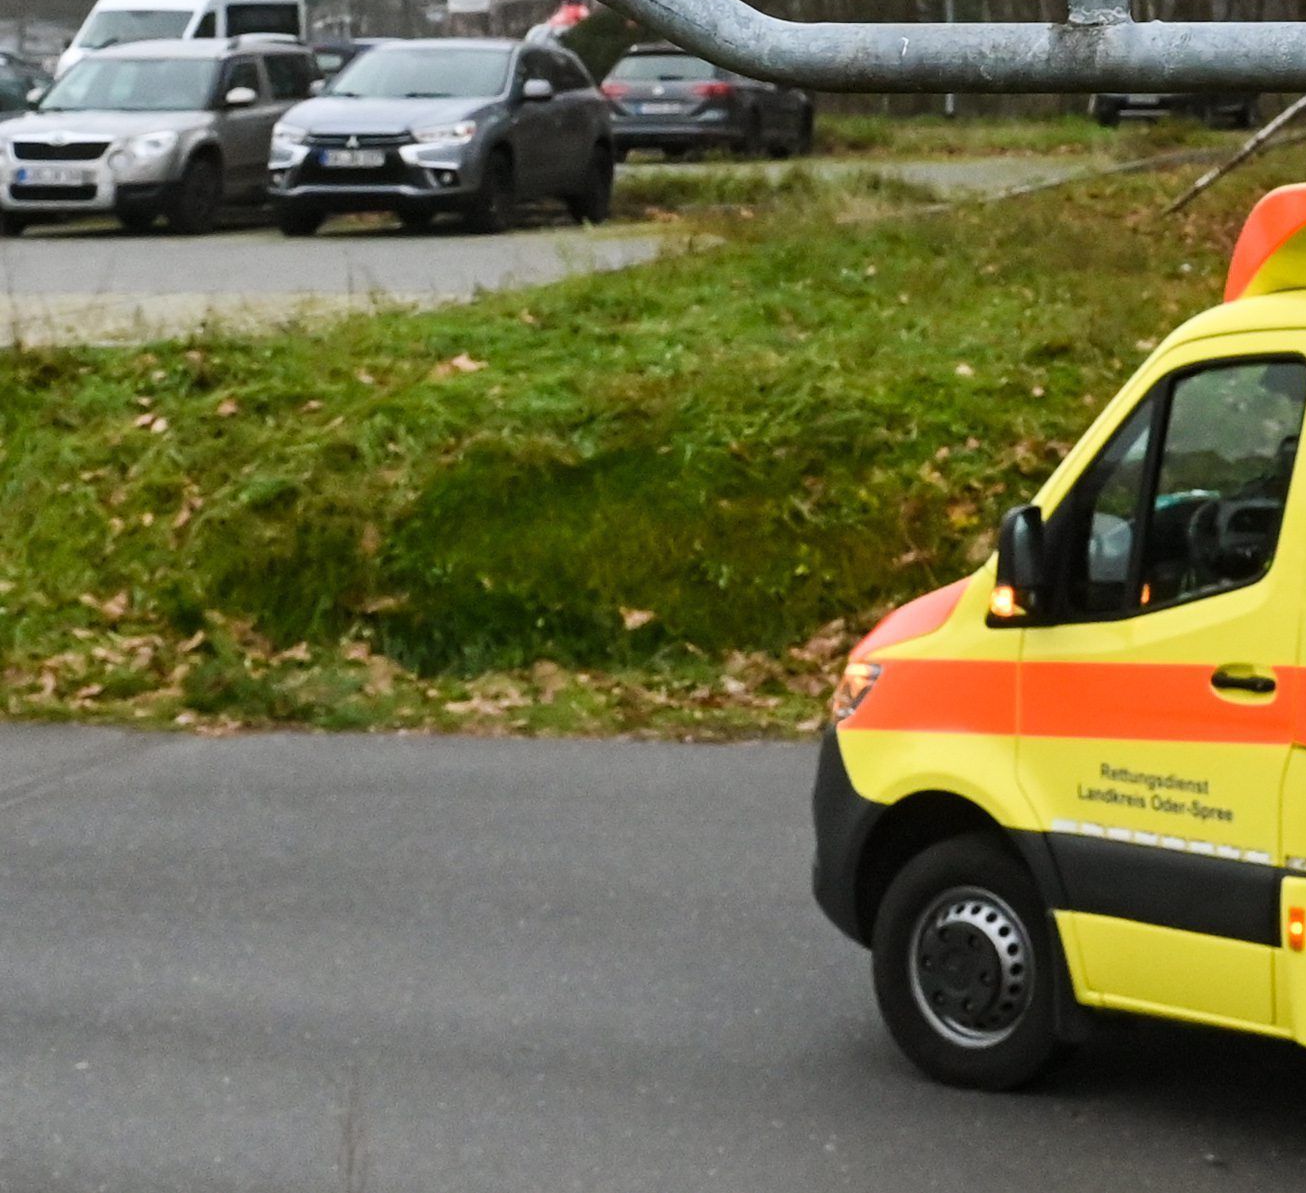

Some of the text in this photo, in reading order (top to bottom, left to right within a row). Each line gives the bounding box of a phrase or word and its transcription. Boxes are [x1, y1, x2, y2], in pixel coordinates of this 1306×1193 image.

[1100, 762, 1209, 794] Rettungsdienst
[1077, 782, 1234, 823] Landkreis Oder-Spree
